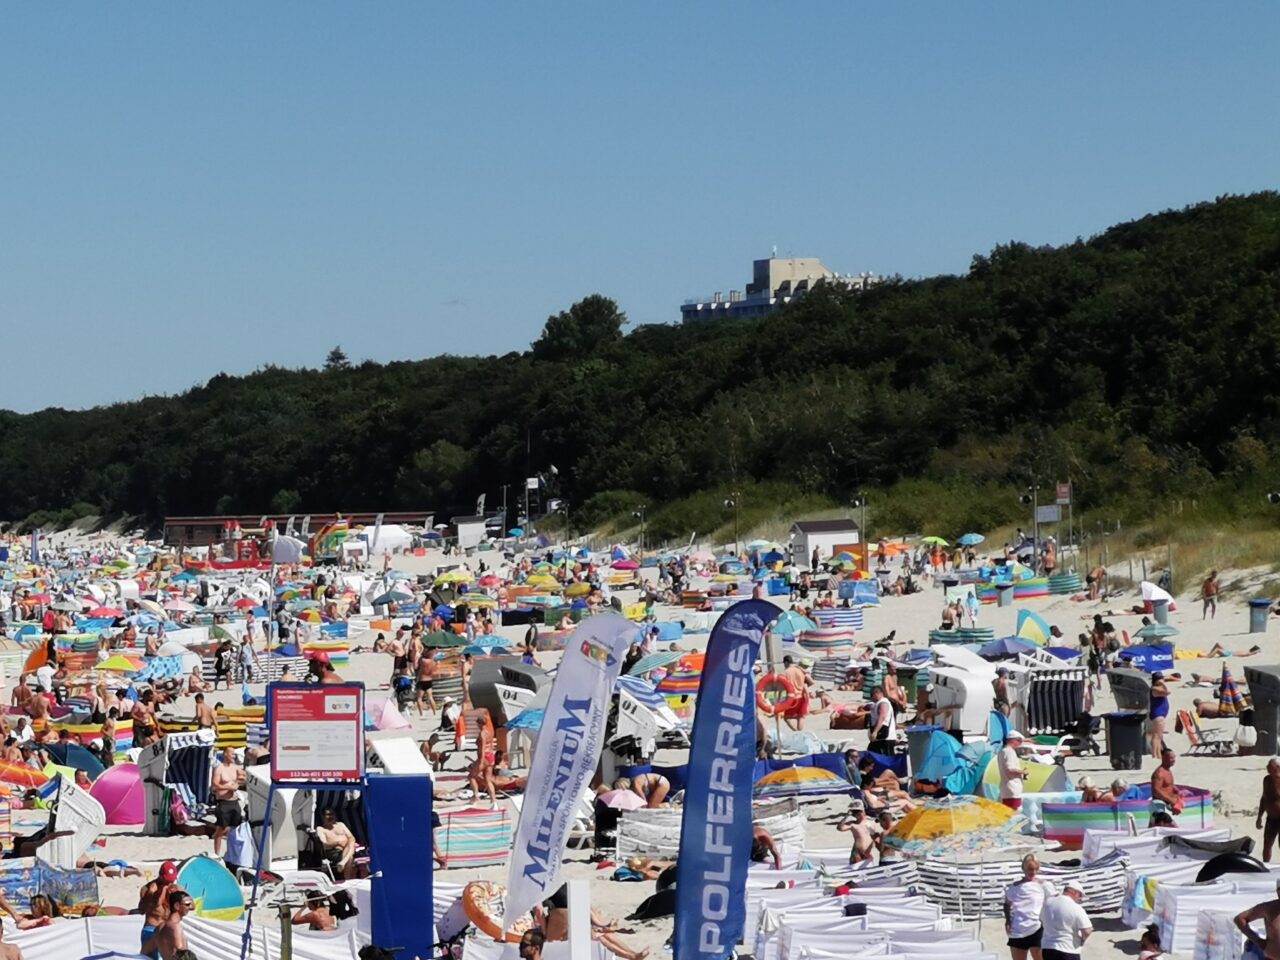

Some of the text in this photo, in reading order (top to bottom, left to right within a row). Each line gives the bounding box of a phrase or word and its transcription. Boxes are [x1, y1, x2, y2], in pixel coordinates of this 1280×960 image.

[503, 688, 518, 701] 04
[622, 699, 638, 714] 01
[63, 784, 76, 796] 73
[699, 643, 750, 954] POLFERRIES
